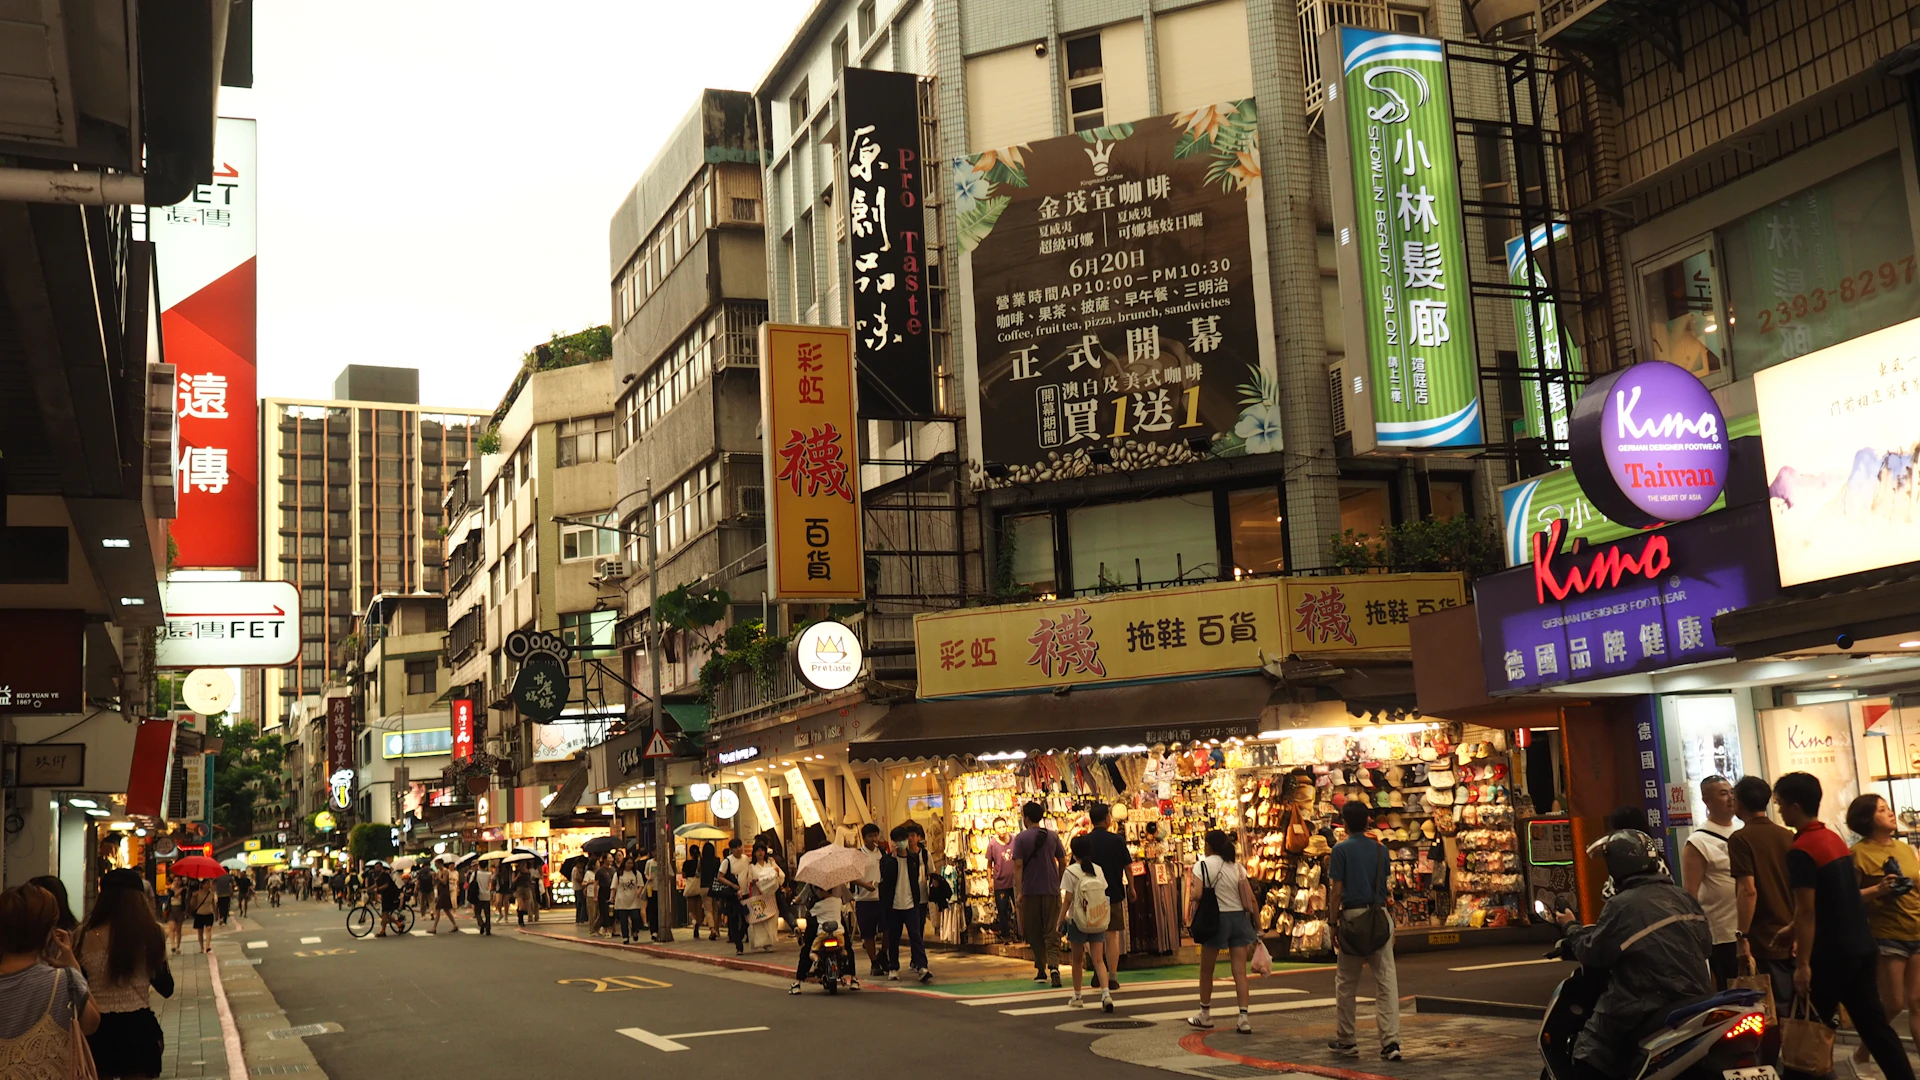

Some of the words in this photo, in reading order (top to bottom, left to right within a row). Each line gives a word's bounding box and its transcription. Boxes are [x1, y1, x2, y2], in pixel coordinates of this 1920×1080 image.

[192, 183, 239, 205] ET
[899, 149, 915, 208] Pro
[1037, 174, 1171, 221] 金茂宜咖啡
[849, 125, 903, 351] 原創品味
[1039, 220, 1073, 238] 夏威夷
[1039, 232, 1094, 255] 超級可娜
[1117, 206, 1152, 224] 夏威夷
[1374, 209, 1392, 278] BEAUTY
[1394, 128, 1450, 347] 小林髮廊
[901, 232, 922, 335] Taste
[1069, 249, 1145, 278] 6月20日
[997, 328, 1034, 343] Coffee,
[1036, 323, 1060, 337] fruit
[1062, 319, 1082, 333] tea,
[1084, 314, 1116, 331] pizza,
[1118, 306, 1163, 324] brunch,
[1165, 296, 1230, 317] sandwiches
[1382, 284, 1398, 346] SALON
[1758, 254, 1916, 335] 2393-8297
[797, 342, 825, 405] 彩虹
[1009, 315, 1223, 382] 正式開幕
[1062, 363, 1203, 400] 澳白及美式咖啡
[178, 372, 230, 494] 遠傳
[1041, 388, 1058, 445] 開幕期間
[1063, 385, 1204, 446] 買1送1
[1616, 386, 1718, 439] Kimo
[776, 422, 854, 503] 襪
[1618, 443, 1648, 452] GERMAN
[1649, 442, 1684, 451] DESIGNER
[1685, 442, 1722, 451] FOOTWEAR
[1624, 462, 1716, 489] Taiwan
[1660, 494, 1679, 502] HEART
[1688, 493, 1702, 501] ASIA
[805, 518, 831, 581] 百貨
[1532, 518, 1671, 604] Kimo
[230, 621, 285, 638] FET
[1294, 585, 1358, 646] 襪
[1365, 599, 1409, 626] 拖鞋
[1542, 611, 1581, 629] GERMAN
[1580, 605, 1629, 622] DESIGNER
[1630, 591, 1687, 611] FOOTWEAR
[940, 636, 998, 672] 彩虹
[1026, 607, 1107, 679] 襪
[1504, 606, 1737, 681] 德國品牌健康
[333, 700, 347, 770] 府城台南美
[1788, 724, 1833, 749] Kimo
